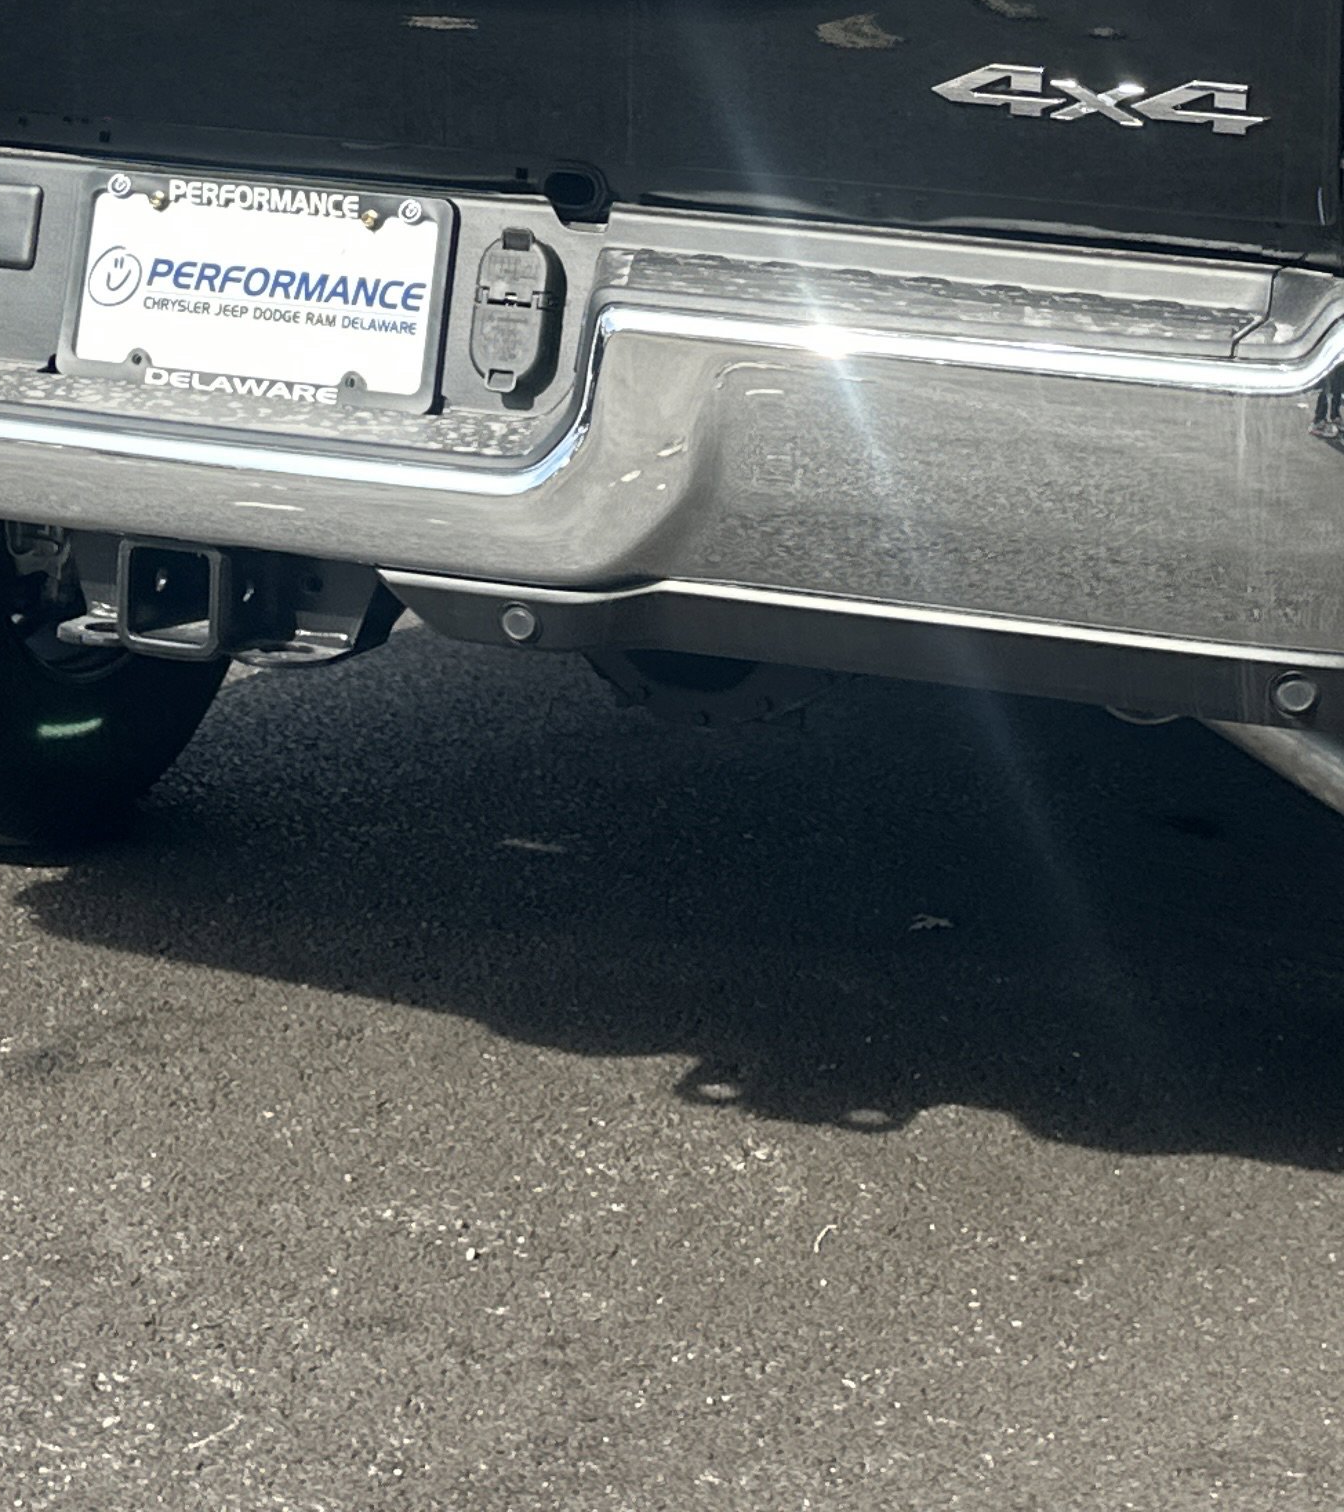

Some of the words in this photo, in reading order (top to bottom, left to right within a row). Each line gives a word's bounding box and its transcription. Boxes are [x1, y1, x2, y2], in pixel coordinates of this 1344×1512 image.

[168, 178, 361, 220] PERFORMANCE
[146, 257, 427, 312] PERFORMANCE
[143, 296, 211, 316] CHRYSLER
[214, 302, 249, 318] JEEP
[252, 306, 301, 324] DODGE
[305, 311, 337, 328] RAM
[341, 315, 418, 336] DELAWARE
[144, 366, 339, 406] DELAWARE
